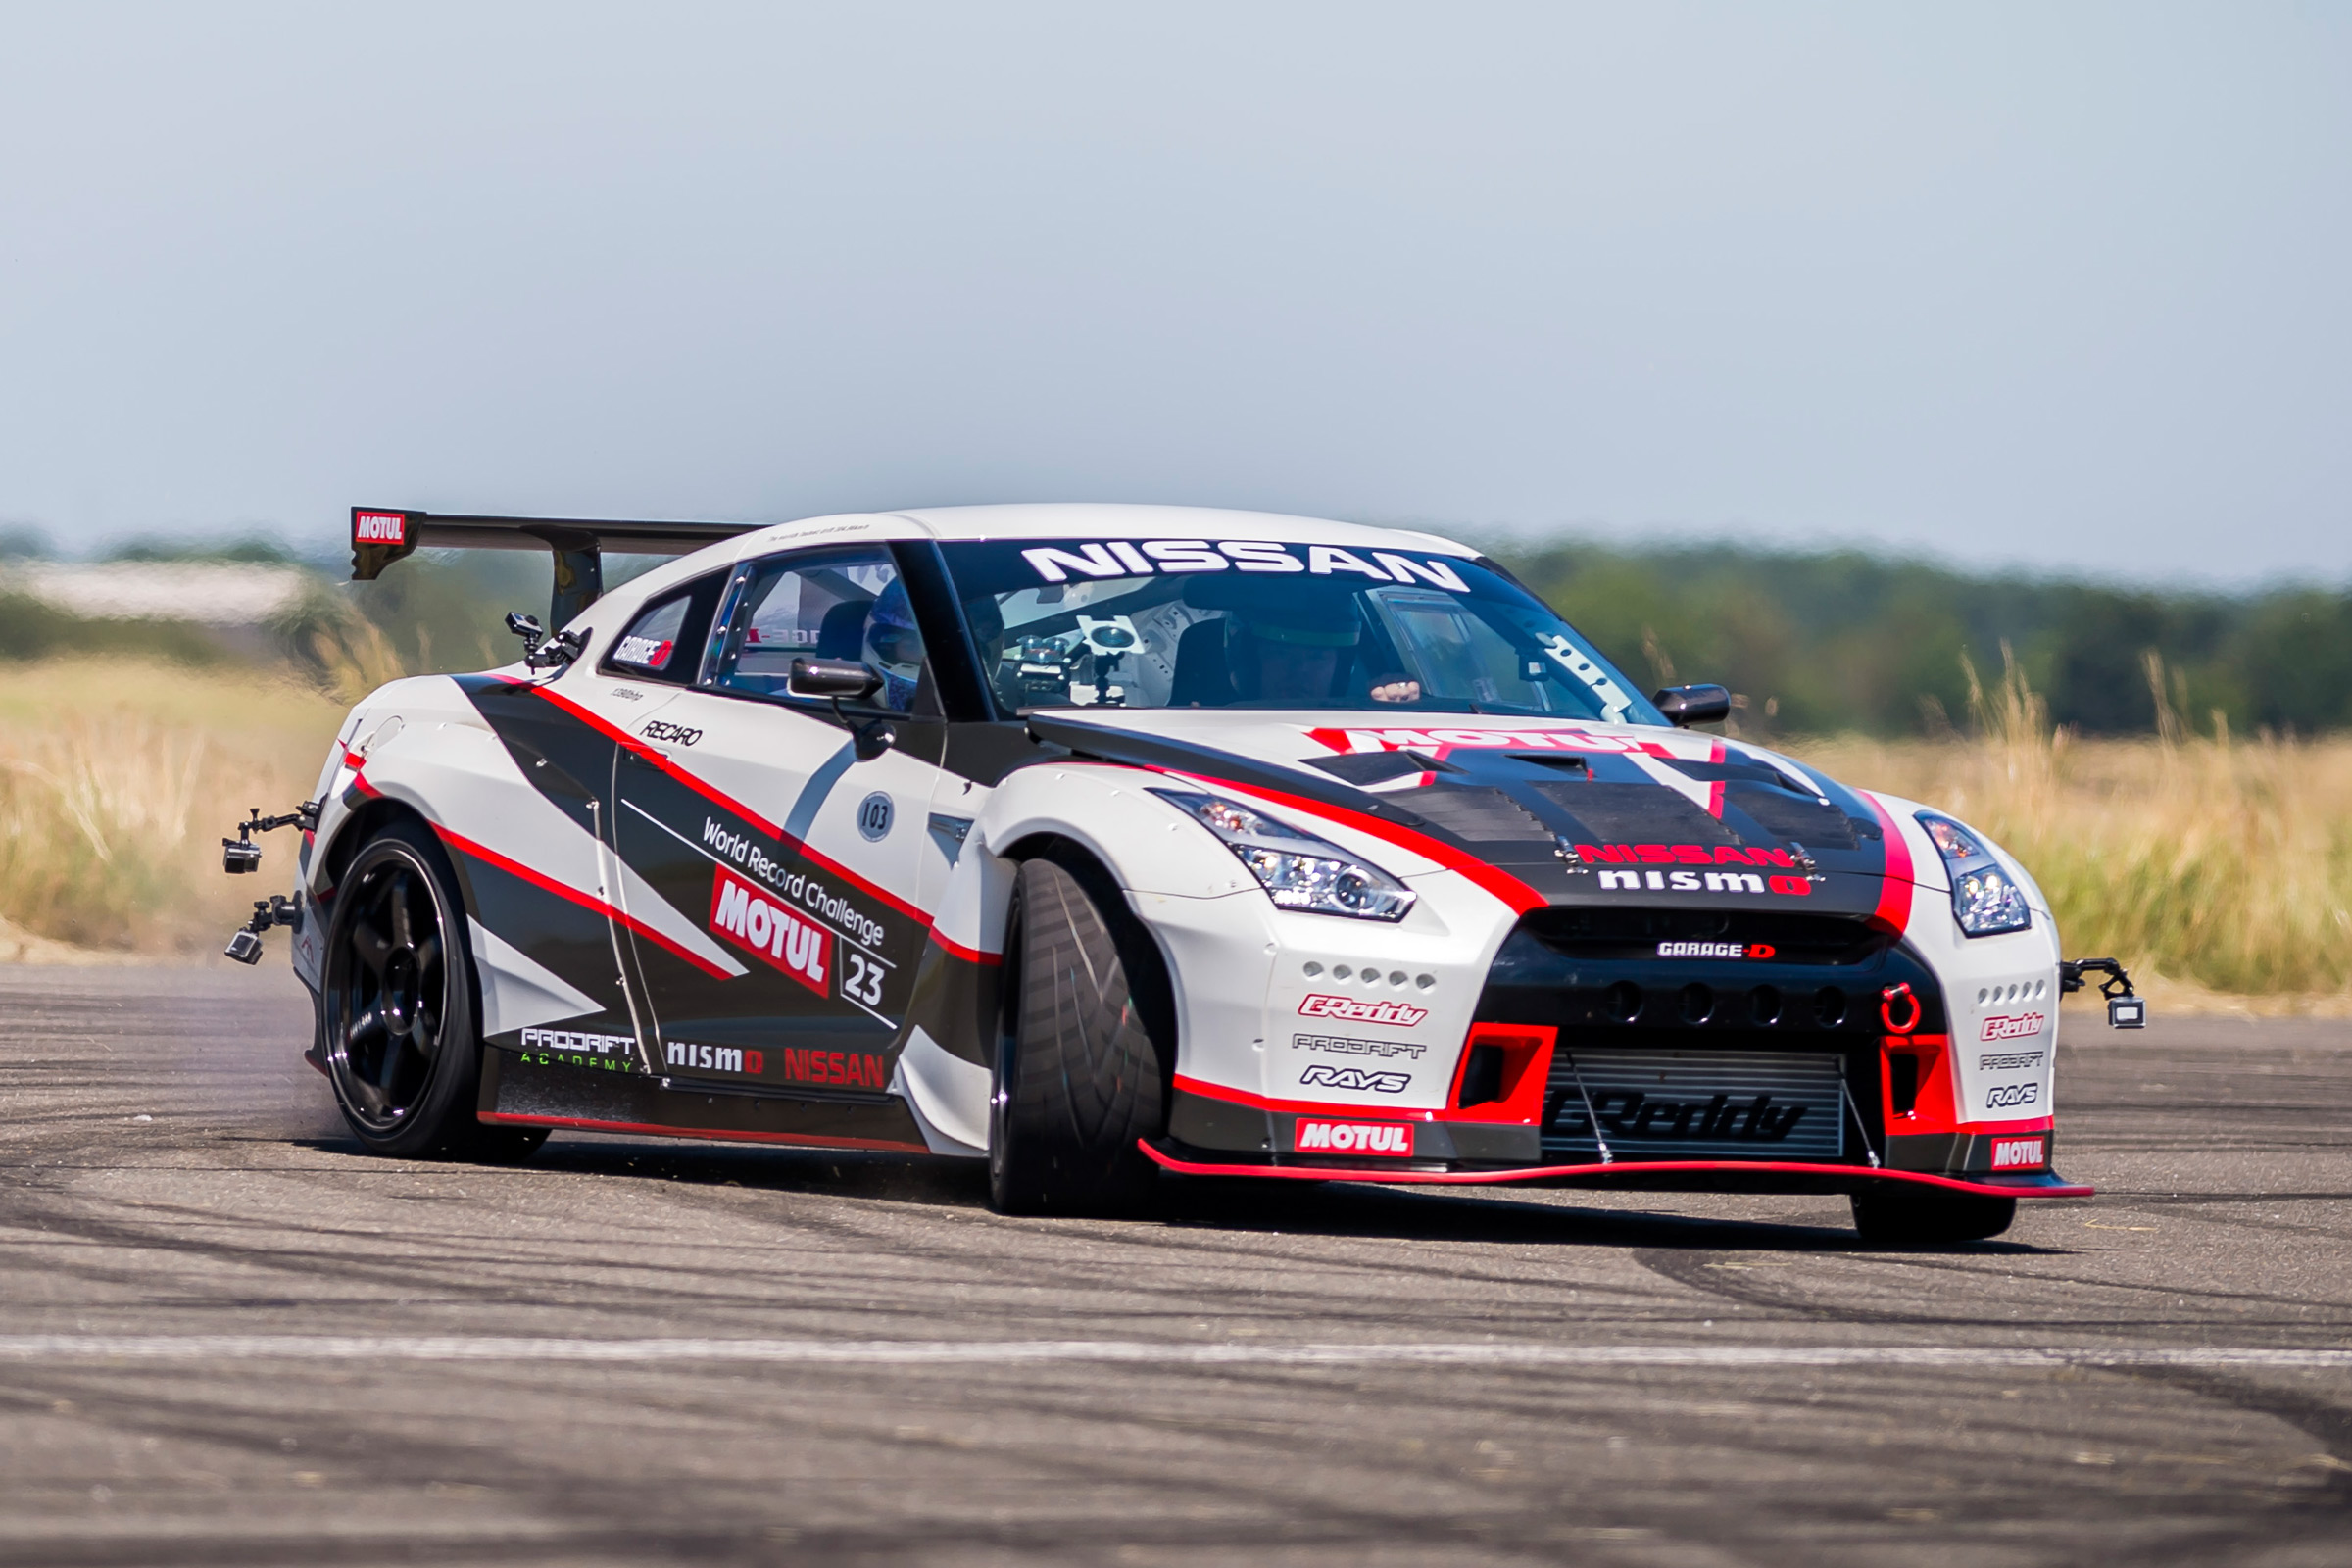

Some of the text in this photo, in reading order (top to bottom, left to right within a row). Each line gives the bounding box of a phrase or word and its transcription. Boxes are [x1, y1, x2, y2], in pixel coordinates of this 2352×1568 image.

[357, 515, 403, 540] MOTUL
[1020, 540, 1471, 593] NISSAN
[639, 719, 704, 747] RECARO
[861, 802, 889, 831] 103
[1574, 844, 1796, 868] NISSAN
[703, 816, 885, 947] World Record Challenge
[1597, 869, 1812, 896] nismo
[714, 878, 825, 983] MOTUL
[1657, 942, 1776, 959] GARAGE-D
[844, 953, 886, 1006] 23
[1298, 993, 1429, 1027] GReddy
[520, 1027, 636, 1055] PRODRIFT
[1980, 1012, 2044, 1042] GReddy
[666, 1041, 764, 1075] nismo
[1292, 1033, 1427, 1059] PRODRIFT
[520, 1052, 632, 1073] ACADEMY
[784, 1047, 886, 1089] NISSAN
[1299, 1064, 1412, 1094] RAYS
[1985, 1082, 2038, 1109] RAYS
[1298, 1122, 1409, 1152] MOTUL
[1993, 1139, 2044, 1167] MOTUL
